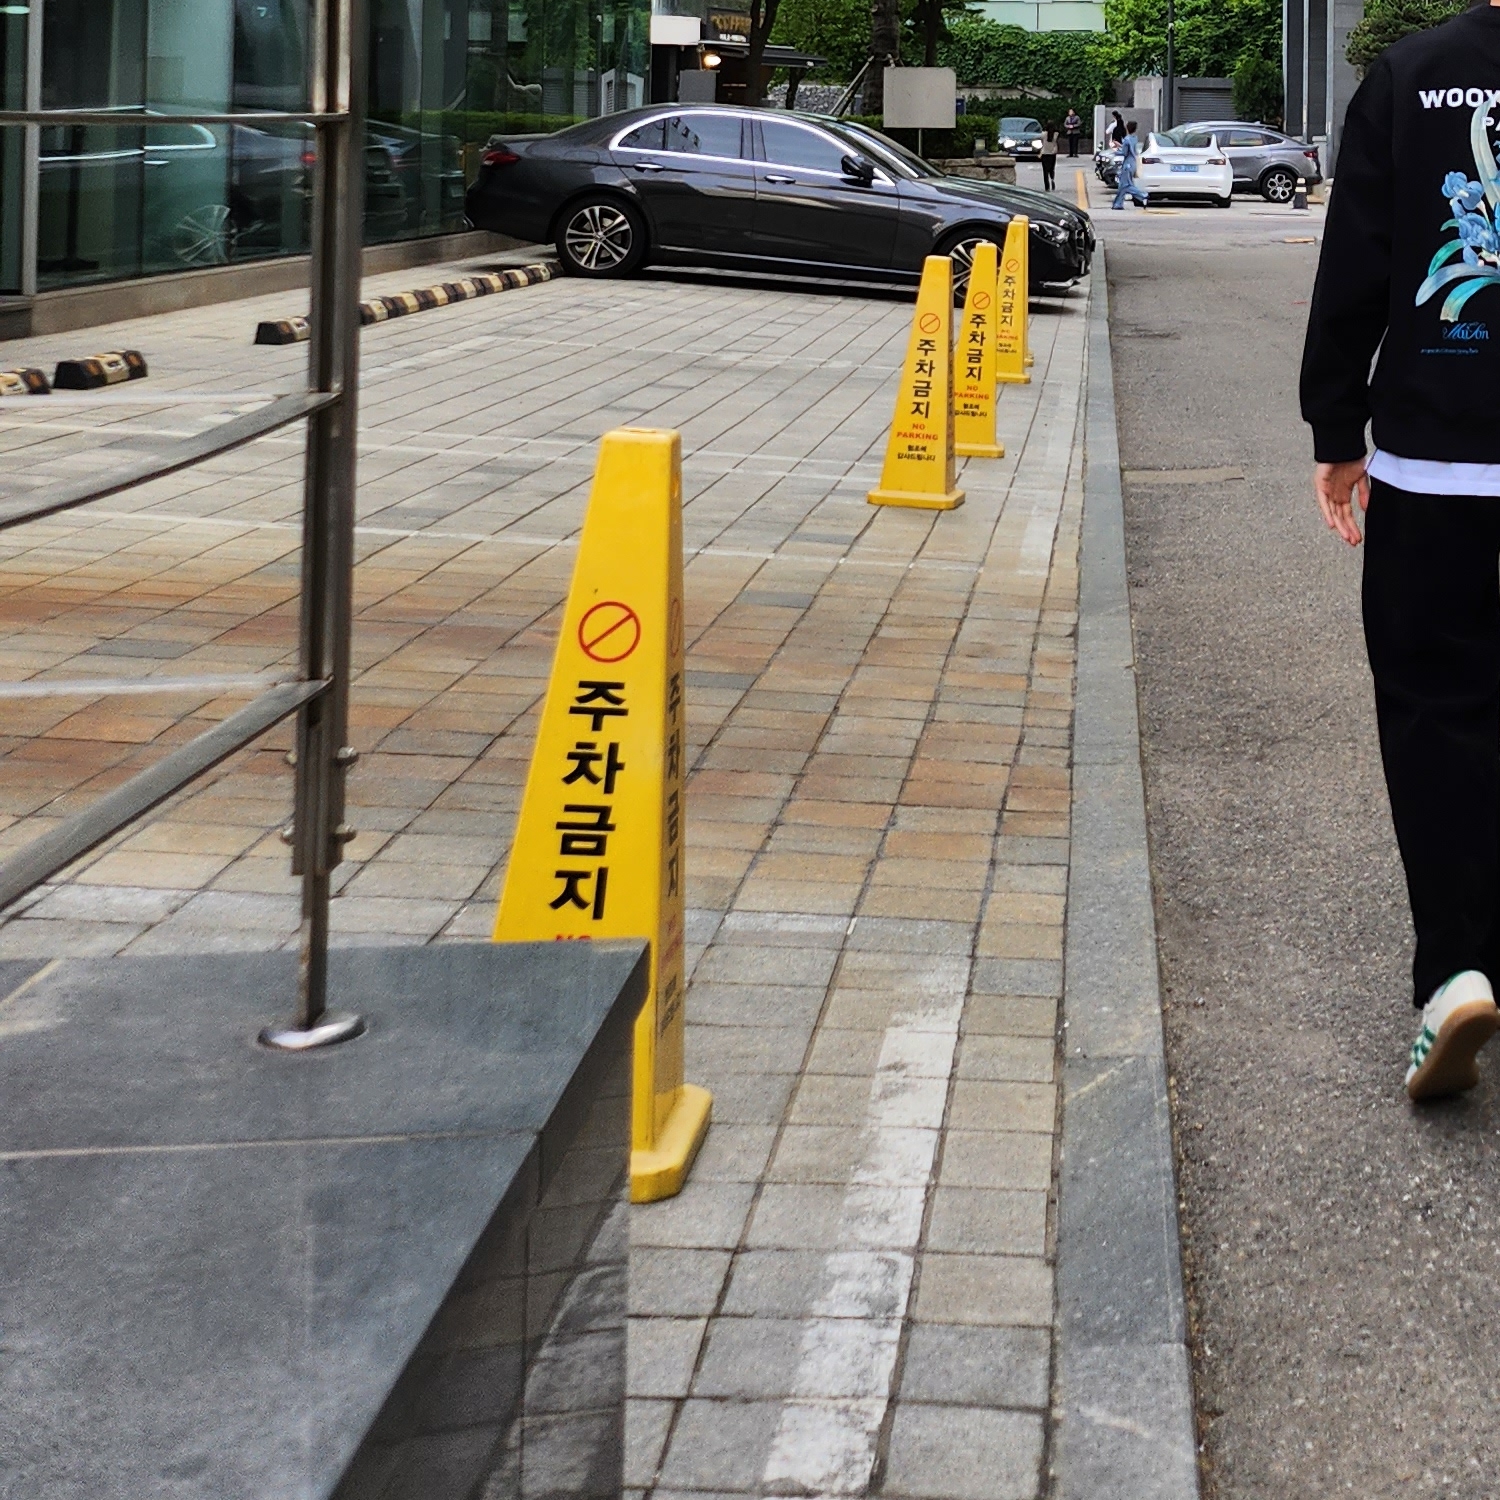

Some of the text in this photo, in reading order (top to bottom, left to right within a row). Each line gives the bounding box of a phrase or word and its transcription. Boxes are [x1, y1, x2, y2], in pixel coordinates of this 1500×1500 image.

[1000, 275, 1016, 326] 주차금지
[910, 338, 937, 419] 주차금지
[965, 313, 987, 381] 주차금지
[896, 431, 939, 441] PARKING
[549, 680, 629, 921] 주차금지
